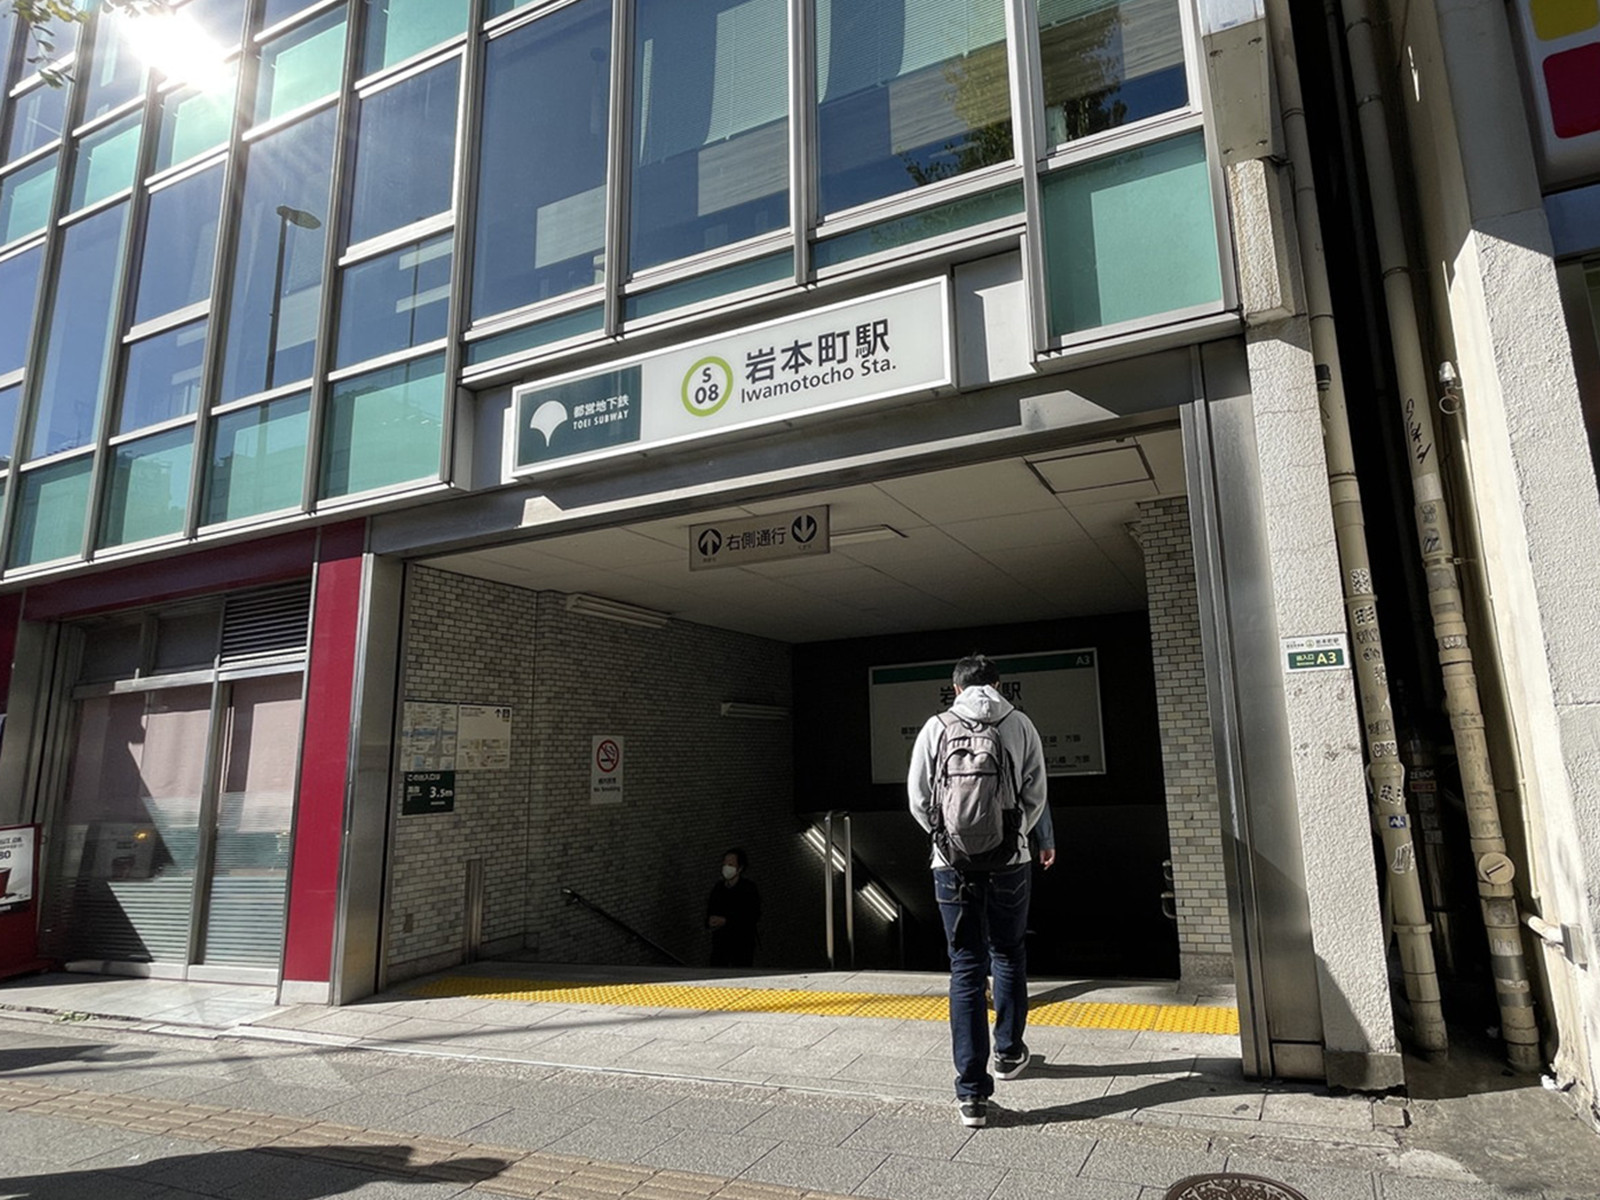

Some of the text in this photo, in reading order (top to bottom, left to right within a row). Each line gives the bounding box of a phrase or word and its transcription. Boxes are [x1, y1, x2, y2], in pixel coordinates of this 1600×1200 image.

[745, 318, 890, 385] 岩本町駅
[702, 366, 712, 383] S
[741, 355, 897, 404] Iwamotocho Sta.
[695, 384, 719, 405] 08
[573, 395, 629, 418] 都営地下鉄
[573, 409, 629, 430] TOEI SUBWAY
[726, 526, 786, 551] 右側通行
[1076, 655, 1091, 666] A3
[1316, 651, 1337, 665] A3
[429, 785, 454, 799] 3.5m
